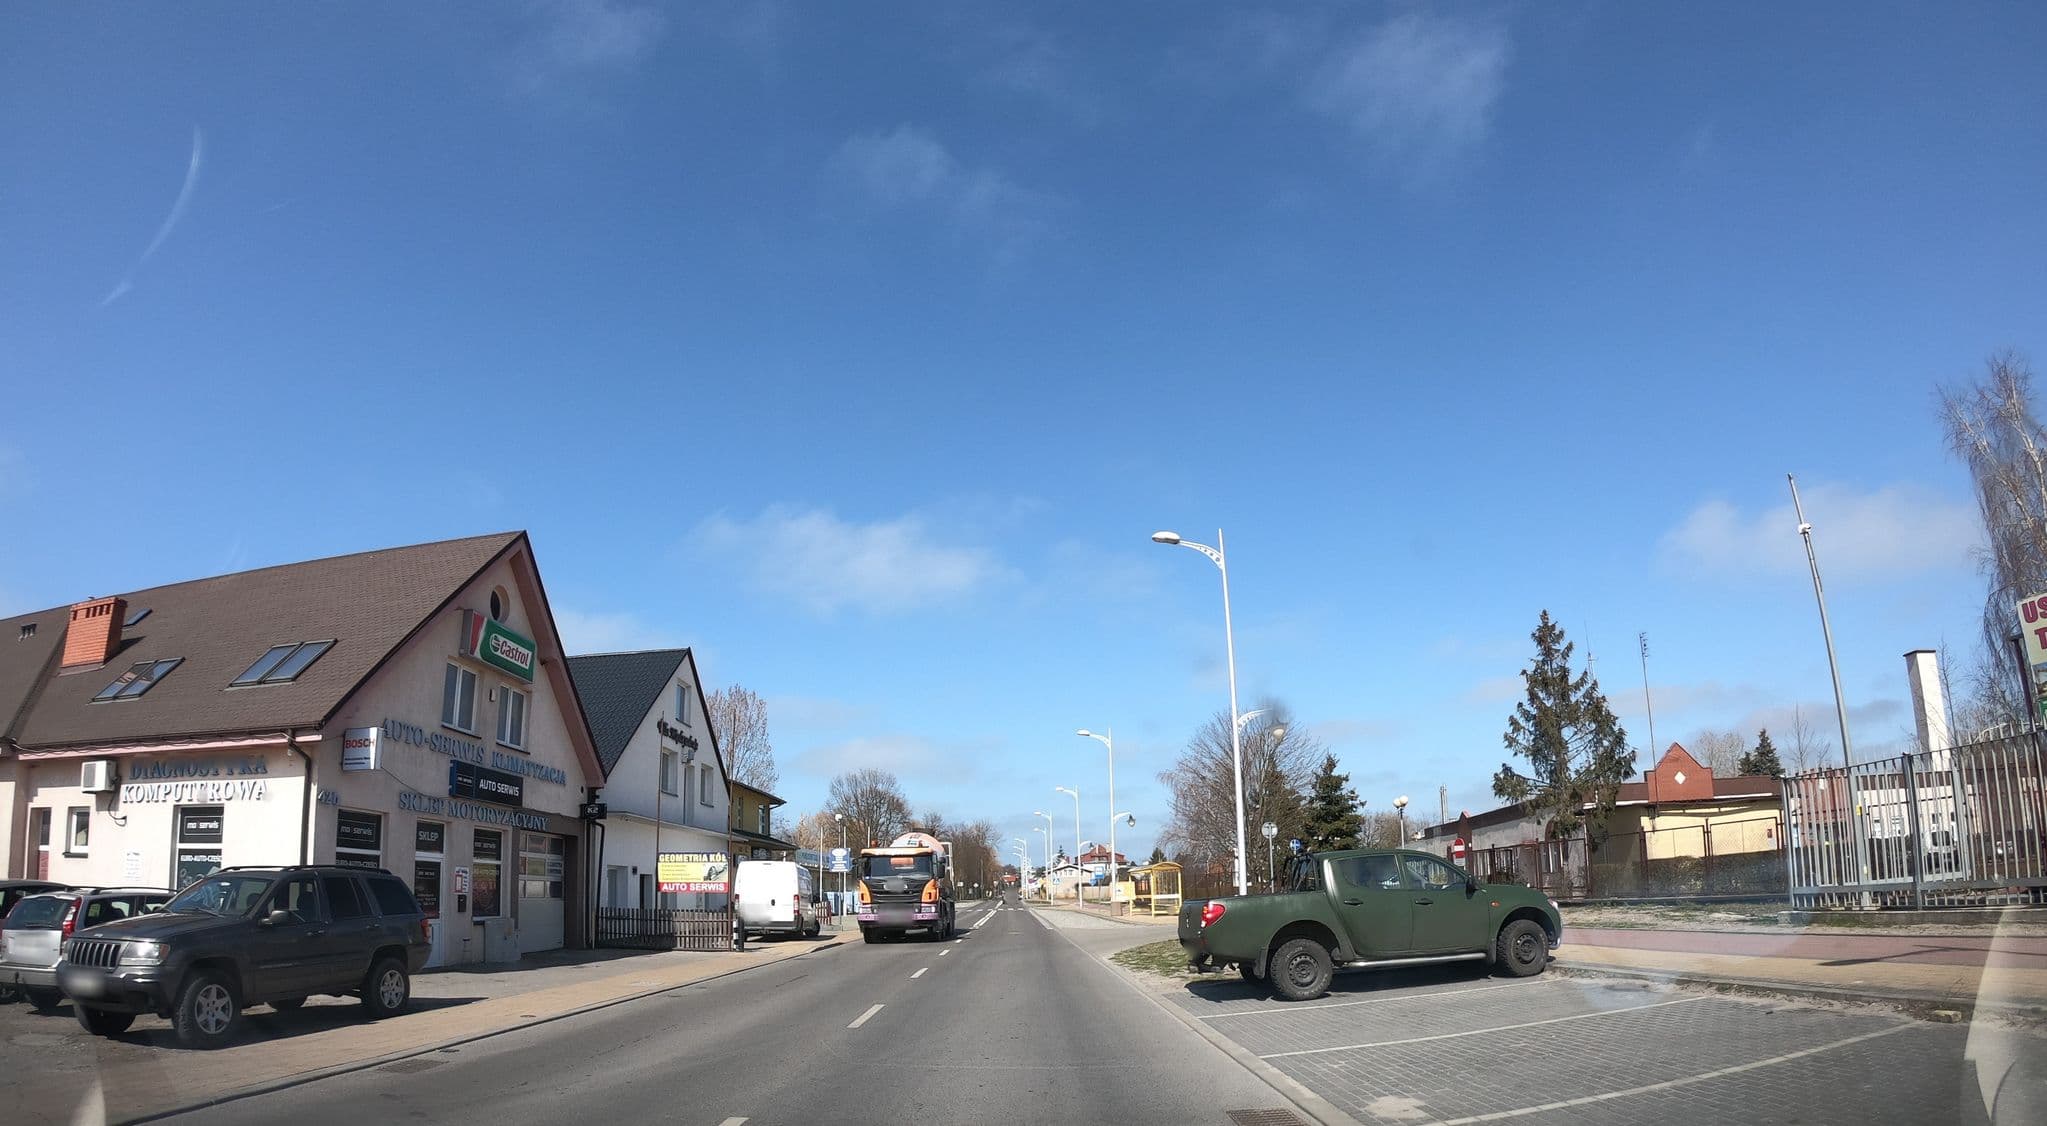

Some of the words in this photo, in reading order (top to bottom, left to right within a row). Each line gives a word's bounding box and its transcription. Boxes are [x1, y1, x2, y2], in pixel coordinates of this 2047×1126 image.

[500, 640, 530, 667] Castrol
[345, 738, 375, 748] BOSCH
[383, 718, 485, 763] AUTO-SERWIS
[491, 751, 566, 785] KLIMATYZACJA
[129, 757, 268, 780] DIAGNOSTYKA
[122, 780, 268, 804] KOMPUTEROWA
[479, 778, 497, 792] AUTO
[497, 782, 520, 797] SERWIS
[400, 792, 444, 814] SKLEP
[447, 801, 549, 832] MOTORYZACYJNY
[418, 831, 440, 842] SKLEP
[658, 853, 708, 862] GEOMETRIA
[662, 882, 688, 891] AUTO
[689, 882, 725, 891] SERWIS
